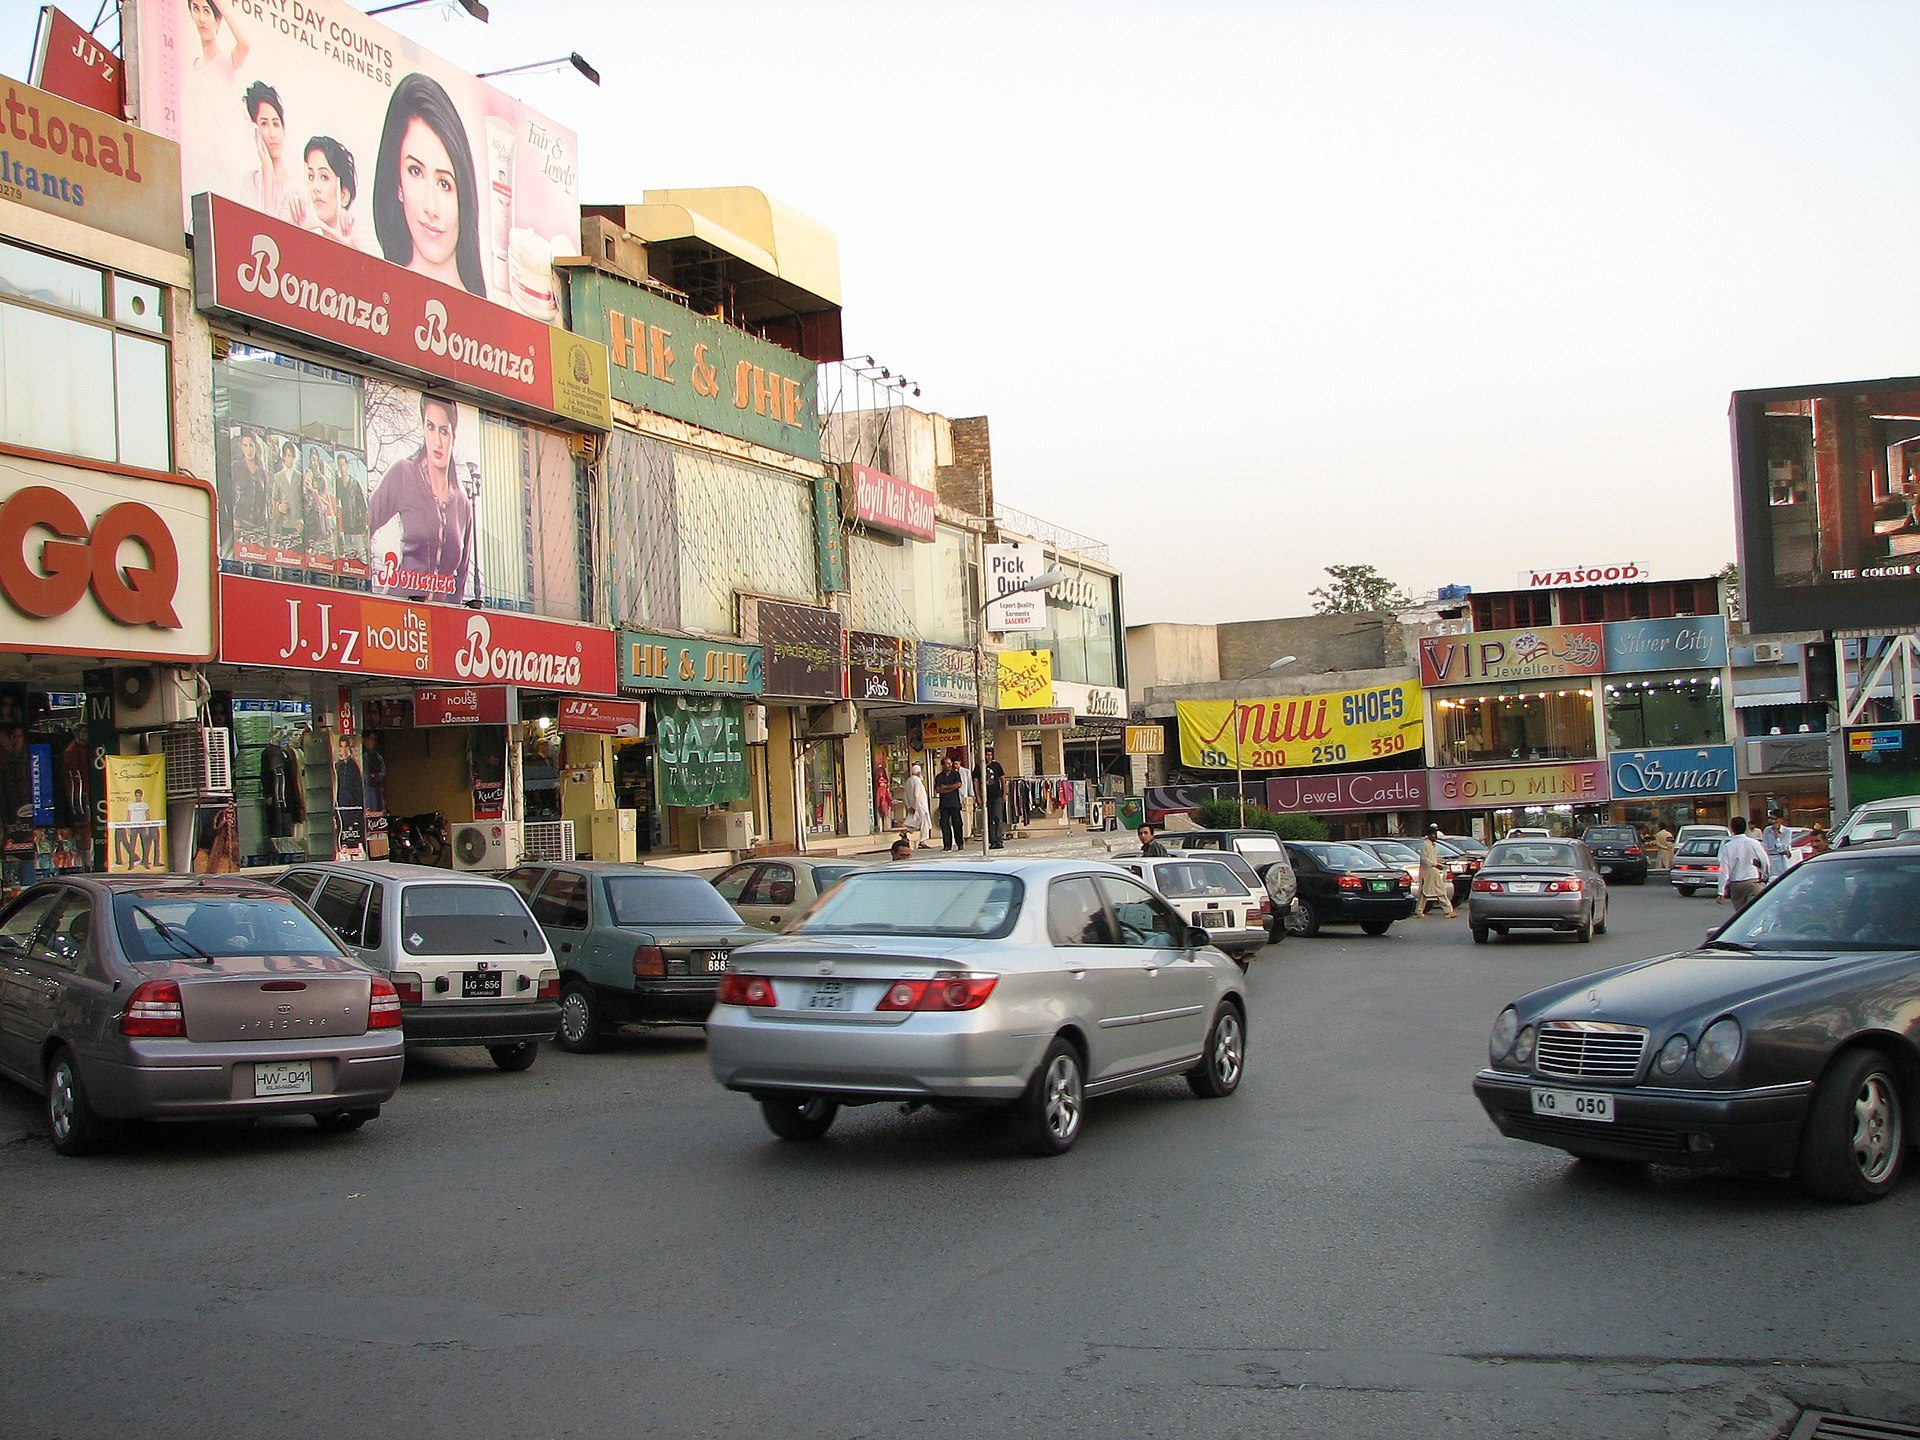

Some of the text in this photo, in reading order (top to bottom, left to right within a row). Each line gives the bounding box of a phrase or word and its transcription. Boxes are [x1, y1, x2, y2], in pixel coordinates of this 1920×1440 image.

[294, 1, 393, 69] DAY COUNTS
[270, 12, 318, 50] TOTAL
[324, 41, 392, 87] FAIRNESS
[164, 107, 175, 123] 21
[0, 87, 141, 183] tional
[527, 120, 565, 159] Fair &
[541, 154, 576, 195] Lovely
[237, 234, 535, 385] Bonanza Bonanza
[610, 310, 675, 385] HE
[692, 343, 719, 399] &
[733, 360, 803, 429] SHE
[885, 481, 906, 522] Nail
[908, 489, 934, 531] Salon
[0, 486, 183, 630] GQ
[993, 556, 1024, 573] Pick
[377, 551, 458, 596] Bonanza
[1530, 565, 1638, 587] MASOOD
[1831, 569, 1856, 581] THE
[1861, 565, 1911, 579] COLOUR
[997, 576, 1034, 596] Quic
[403, 609, 427, 630] the
[1005, 617, 1031, 625] BASEMENT
[415, 614, 582, 686] of Bonanza
[1614, 628, 1670, 655] Silver
[1675, 629, 1714, 662] City
[632, 643, 669, 679] HE
[677, 648, 695, 682] &
[703, 650, 748, 684] SHE
[1424, 640, 1505, 681] VIP
[1493, 663, 1565, 678] Jewellers
[923, 672, 948, 687] NEW
[1016, 674, 1048, 703] Mall
[934, 690, 957, 699] DIGITAL
[1087, 689, 1119, 716] Bata
[1342, 687, 1403, 726] SHOES
[92, 696, 110, 720] M
[441, 711, 480, 723] Bonanza
[658, 716, 741, 763] GAZE
[938, 725, 960, 735] Kodak
[939, 734, 961, 742] COLOR
[1312, 744, 1346, 764] 250
[1371, 734, 1405, 757] 350
[95, 747, 106, 770] &
[1200, 749, 1287, 768] 150 200
[1442, 772, 1596, 798] GOLD MINE
[1616, 760, 1727, 793] Sunar
[1278, 774, 1420, 809] Jewel Castle
[708, 960, 726, 972] 888
[465, 980, 477, 989] LG
[484, 980, 500, 990] 856
[256, 1071, 311, 1086] HW-041
[1537, 1092, 1606, 1114] KG 050
